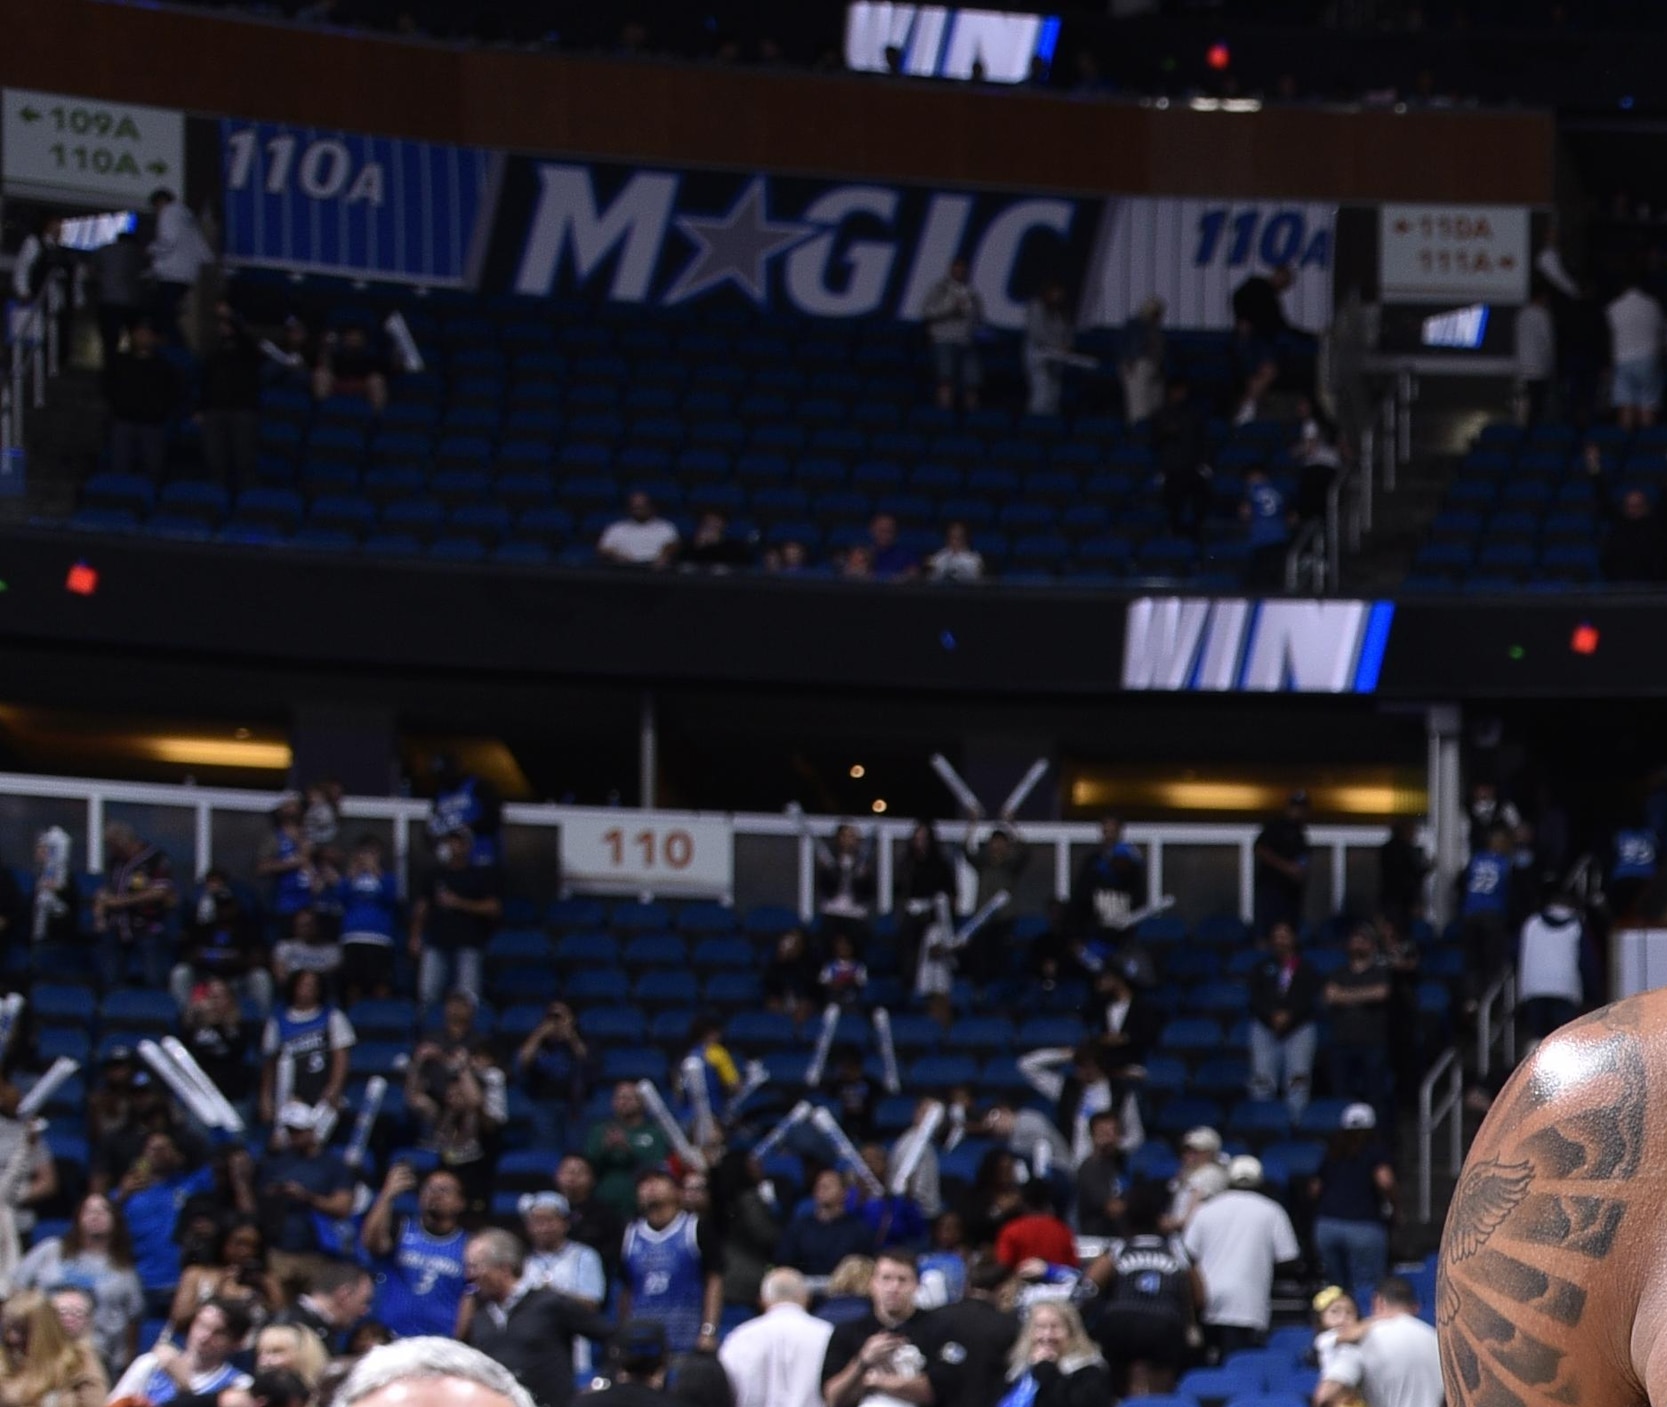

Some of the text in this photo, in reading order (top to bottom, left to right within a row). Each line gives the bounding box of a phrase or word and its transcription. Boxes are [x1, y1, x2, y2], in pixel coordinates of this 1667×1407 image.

[226, 128, 386, 208] 110A
[1194, 209, 1331, 269] 110A
[601, 826, 696, 870] 110
